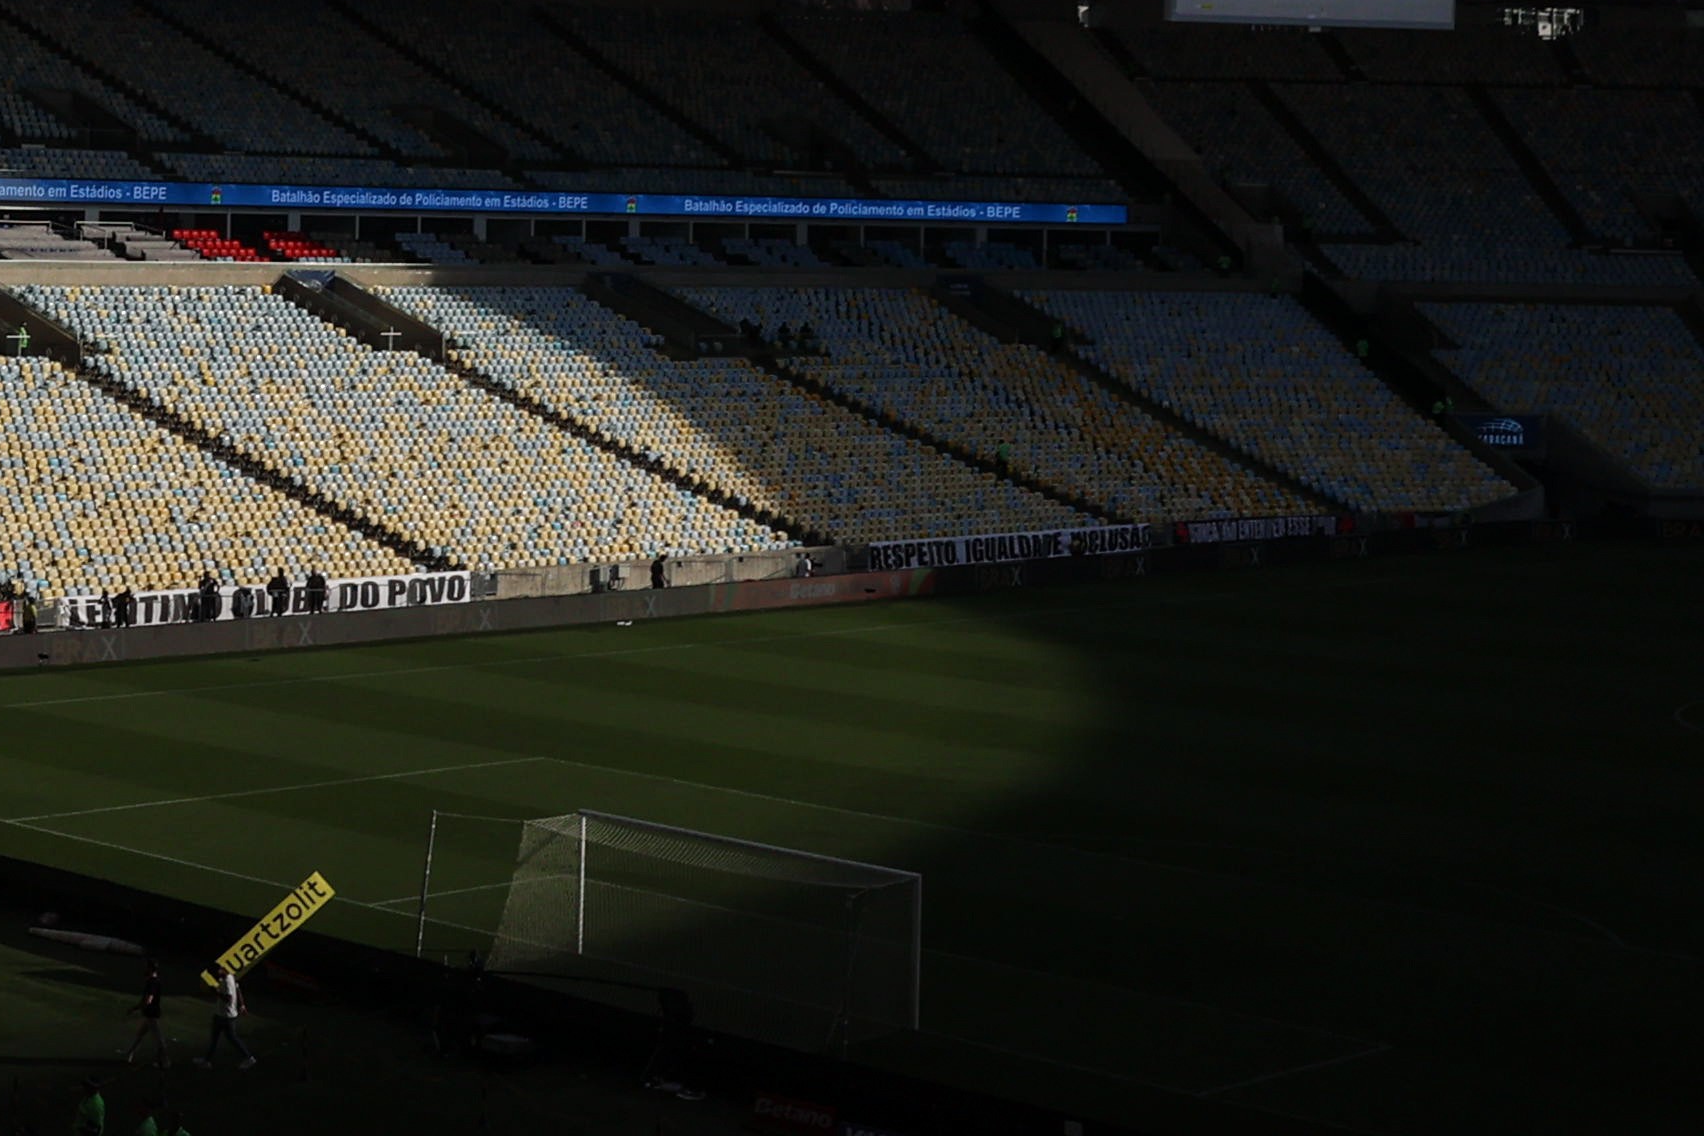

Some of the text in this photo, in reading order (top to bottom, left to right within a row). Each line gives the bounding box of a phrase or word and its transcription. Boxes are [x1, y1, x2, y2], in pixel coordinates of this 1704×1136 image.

[48, 186, 67, 197] em
[70, 184, 123, 199] Estádios
[133, 186, 167, 200] BEPE
[271, 189, 321, 204] Batalhão
[323, 191, 397, 206] Especializado
[399, 193, 413, 205] de
[415, 193, 482, 207] Policiamento
[484, 197, 501, 207] em
[503, 195, 549, 208] Estádios
[558, 196, 588, 209] BEPE
[338, 581, 380, 609] DO
[388, 575, 466, 606] POVO
[220, 880, 326, 977] uartzolit
